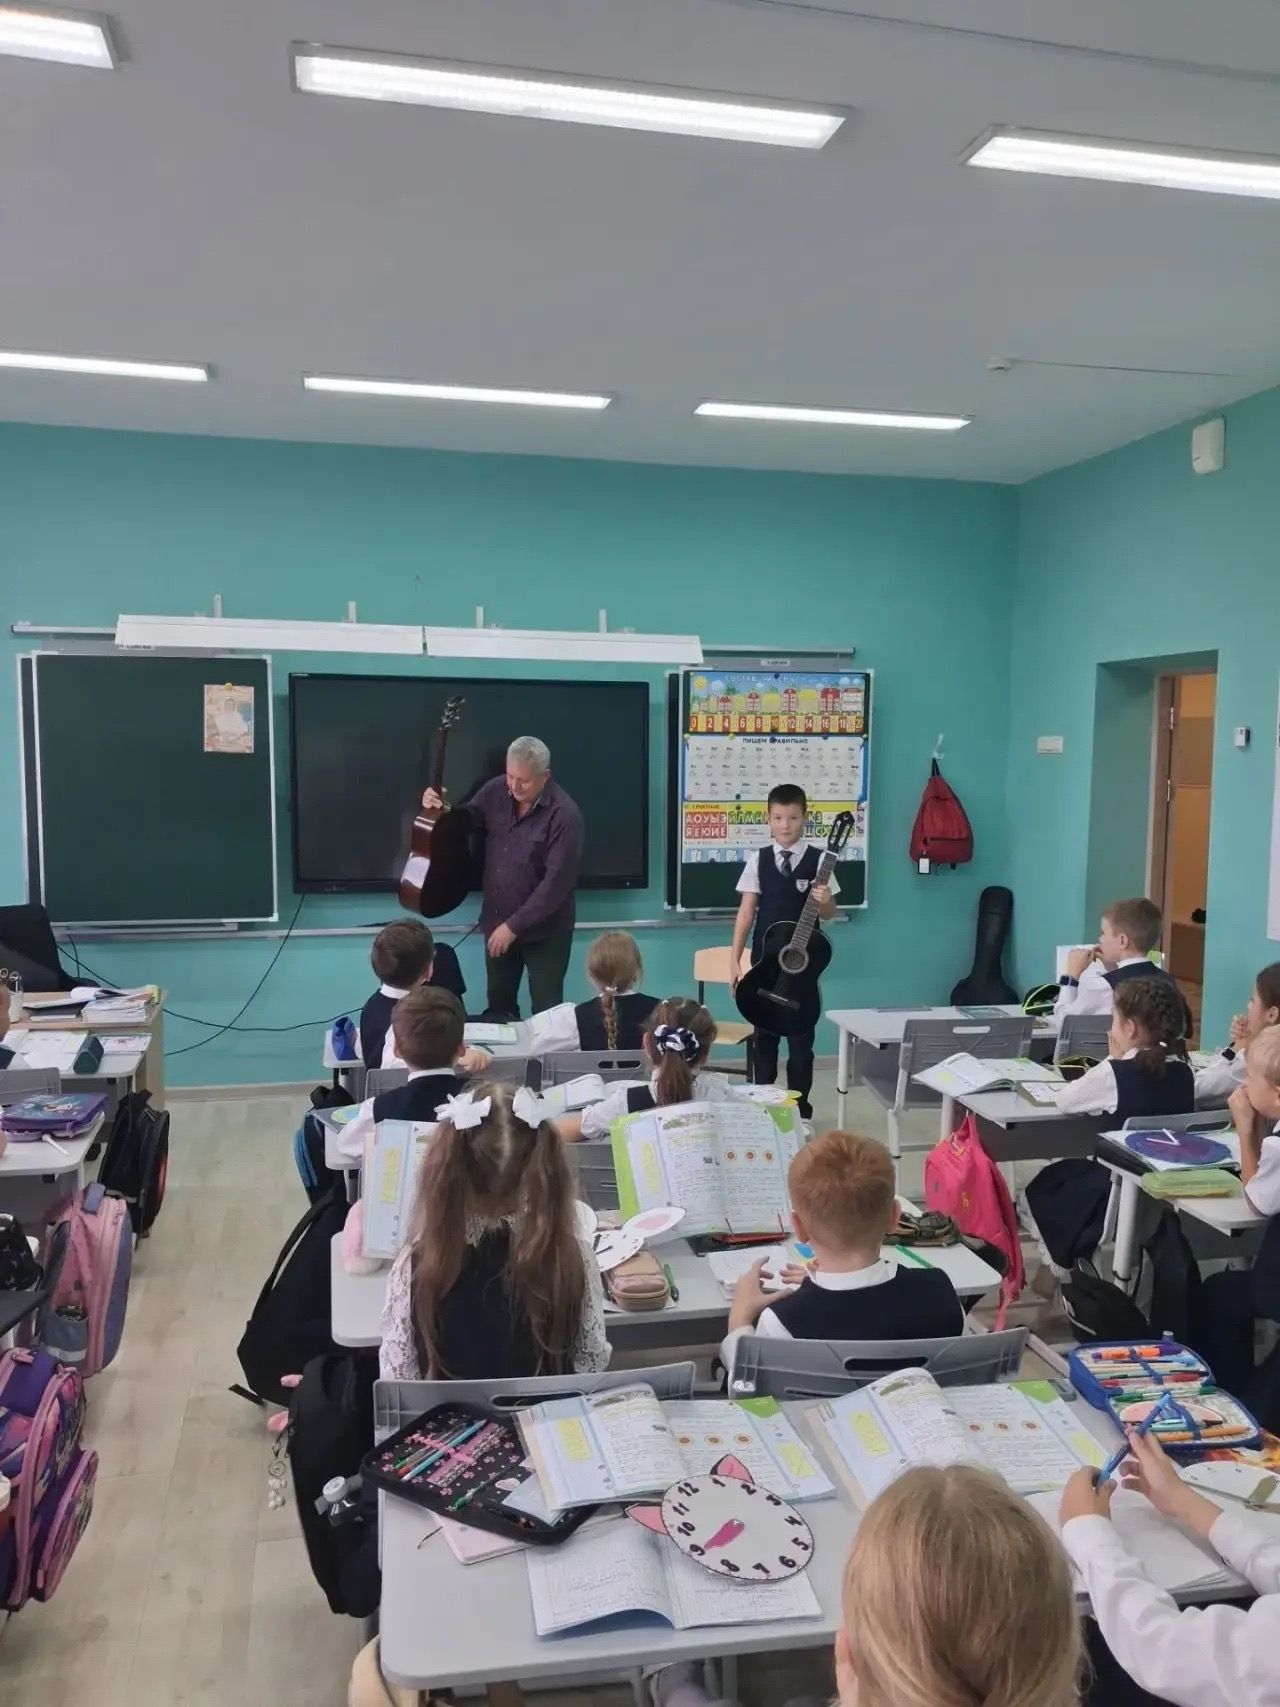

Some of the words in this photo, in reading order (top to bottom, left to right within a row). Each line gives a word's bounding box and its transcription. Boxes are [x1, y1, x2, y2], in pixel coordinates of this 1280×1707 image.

[691, 719, 697, 728] 0
[707, 718, 713, 728] 2
[723, 718, 729, 728] 4
[740, 718, 745, 728] 6
[755, 718, 761, 728] 8
[771, 718, 779, 728] 10
[788, 718, 796, 728] 12
[805, 718, 813, 728] 14
[822, 718, 830, 728] 16
[677, 1482, 699, 1497] 12
[712, 1478, 726, 1488] 1
[741, 1483, 757, 1495] 2
[766, 1494, 782, 1507] 3
[672, 1503, 690, 1516] 11
[784, 1515, 803, 1527] 4
[677, 1521, 696, 1536] 10
[689, 1543, 706, 1556] 9
[791, 1537, 810, 1551] 5
[721, 1558, 740, 1573] 8
[753, 1562, 771, 1575] 7
[779, 1555, 797, 1569] 6
